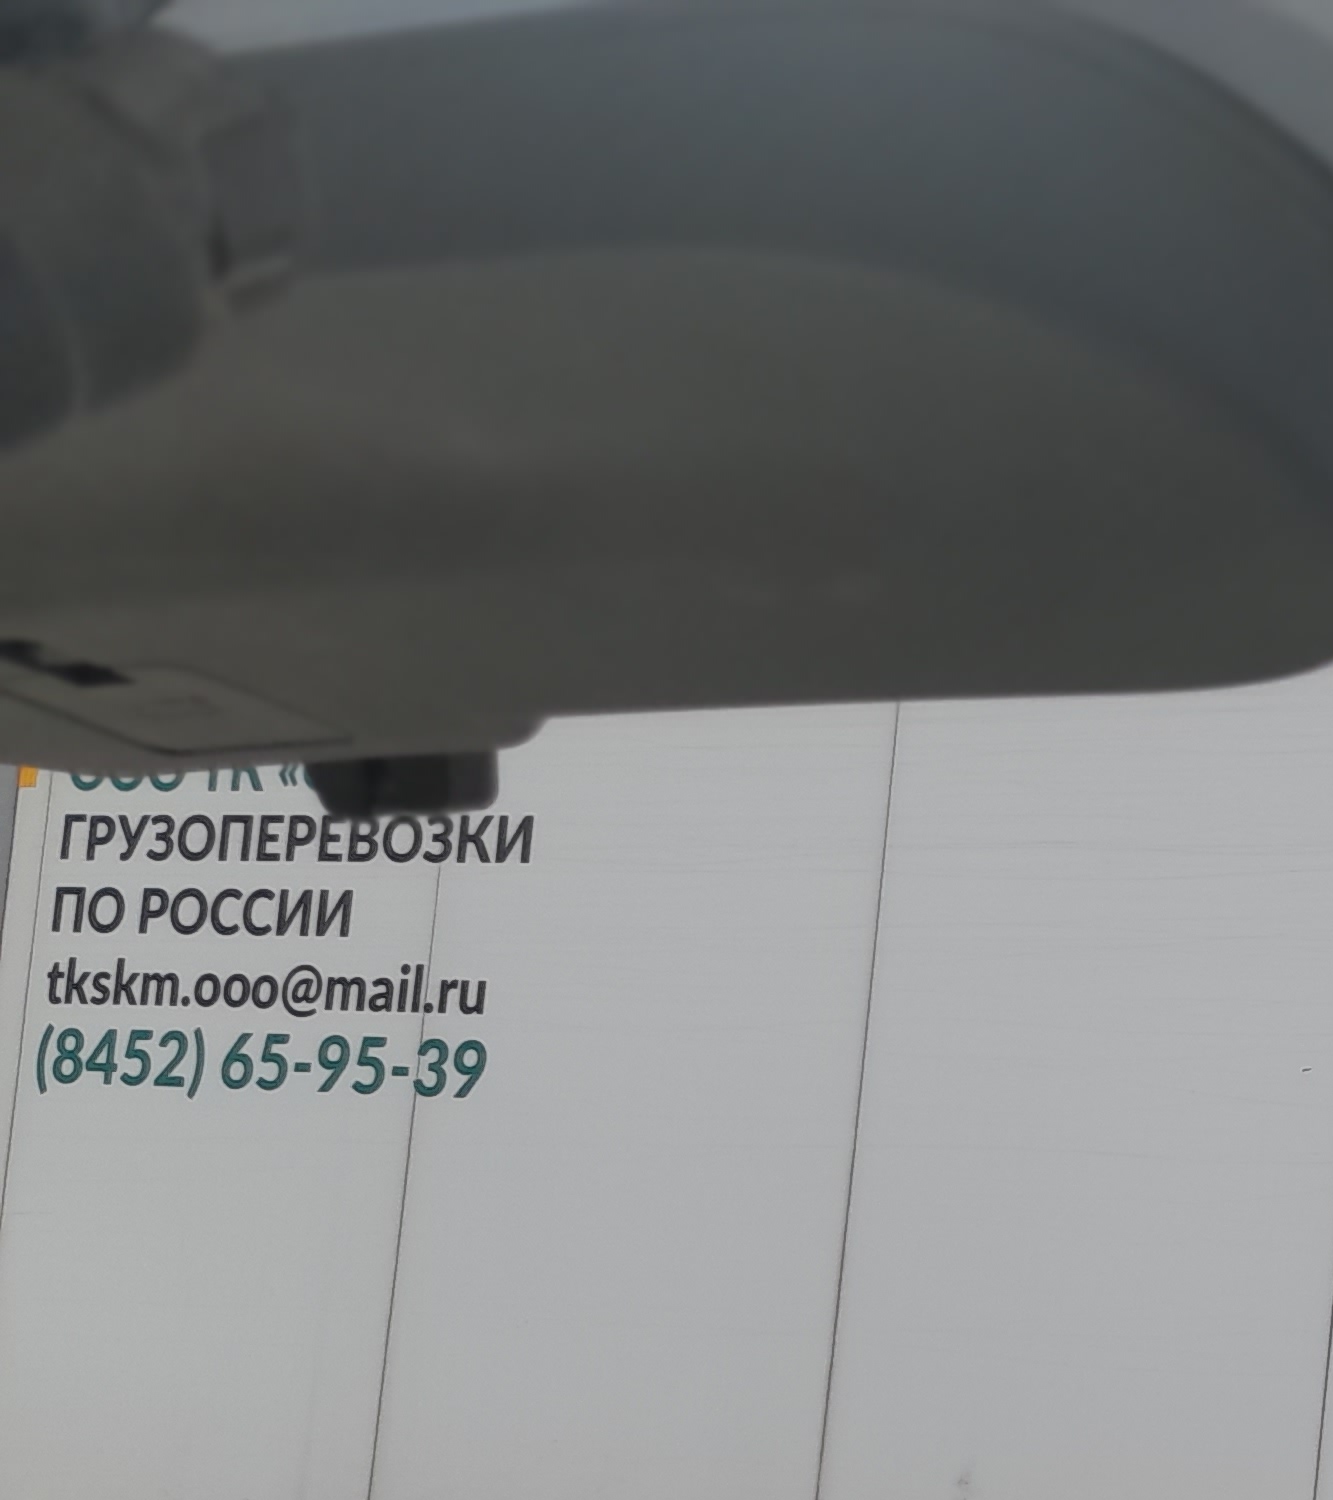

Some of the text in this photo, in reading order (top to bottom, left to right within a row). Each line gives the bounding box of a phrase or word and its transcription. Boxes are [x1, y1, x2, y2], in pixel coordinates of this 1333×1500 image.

[59, 813, 535, 864] ГРУЗОПЕРЕВОЗКИ
[51, 886, 354, 937] ПО РОССИИ
[47, 957, 487, 1017] tkskm.ooo@mail.ru
[36, 1023, 488, 1100] (8452) 65-95-39
